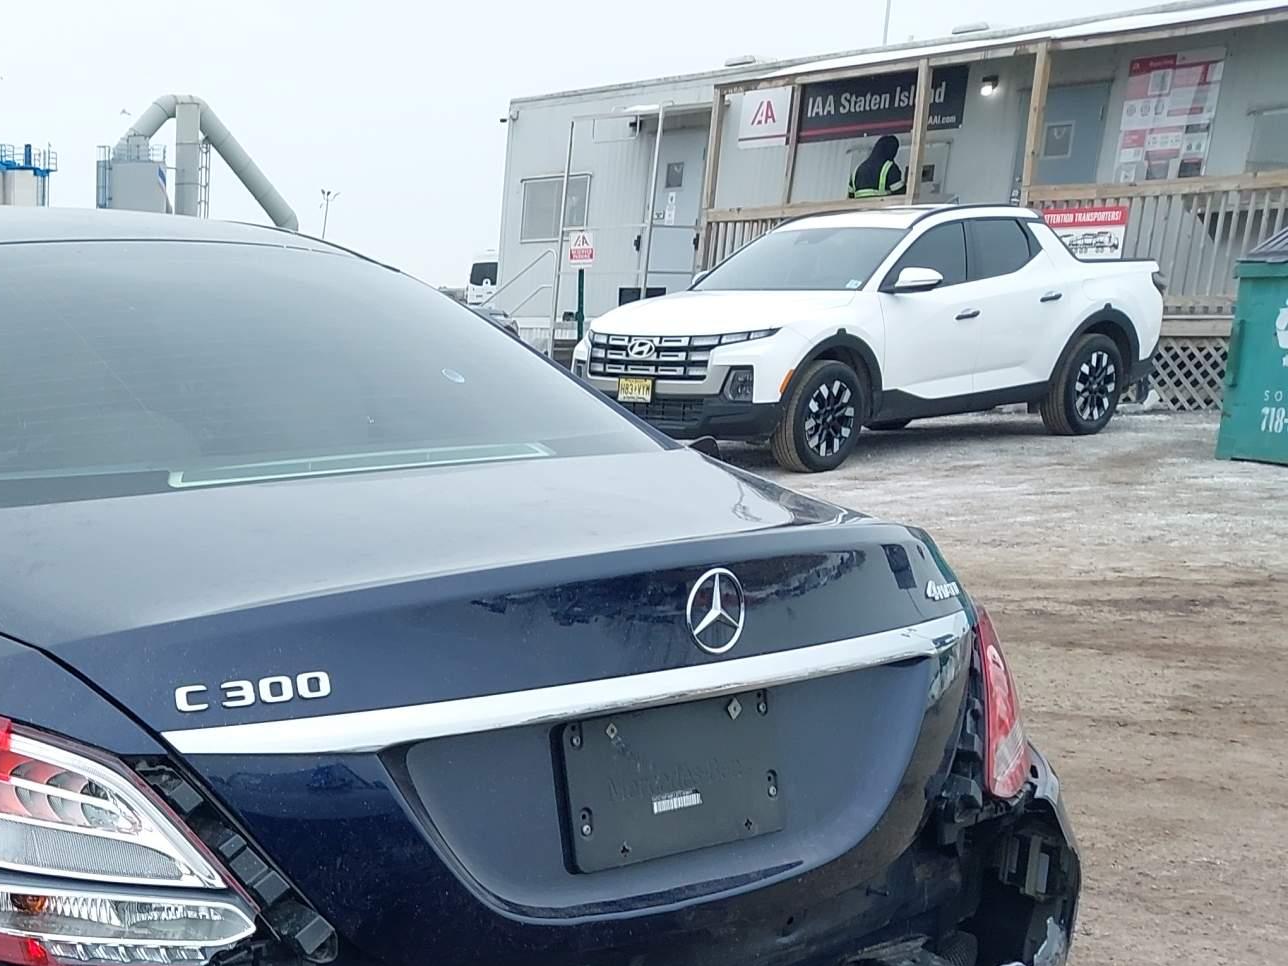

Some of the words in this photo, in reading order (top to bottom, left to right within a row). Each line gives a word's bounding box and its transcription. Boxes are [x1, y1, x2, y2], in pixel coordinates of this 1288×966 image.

[807, 95, 835, 118] IAA
[839, 89, 890, 114] Staten
[894, 81, 946, 108] Isld
[1074, 210, 1122, 223] TRANSPORTERS!
[174, 684, 209, 713] C
[220, 671, 332, 709] 300
